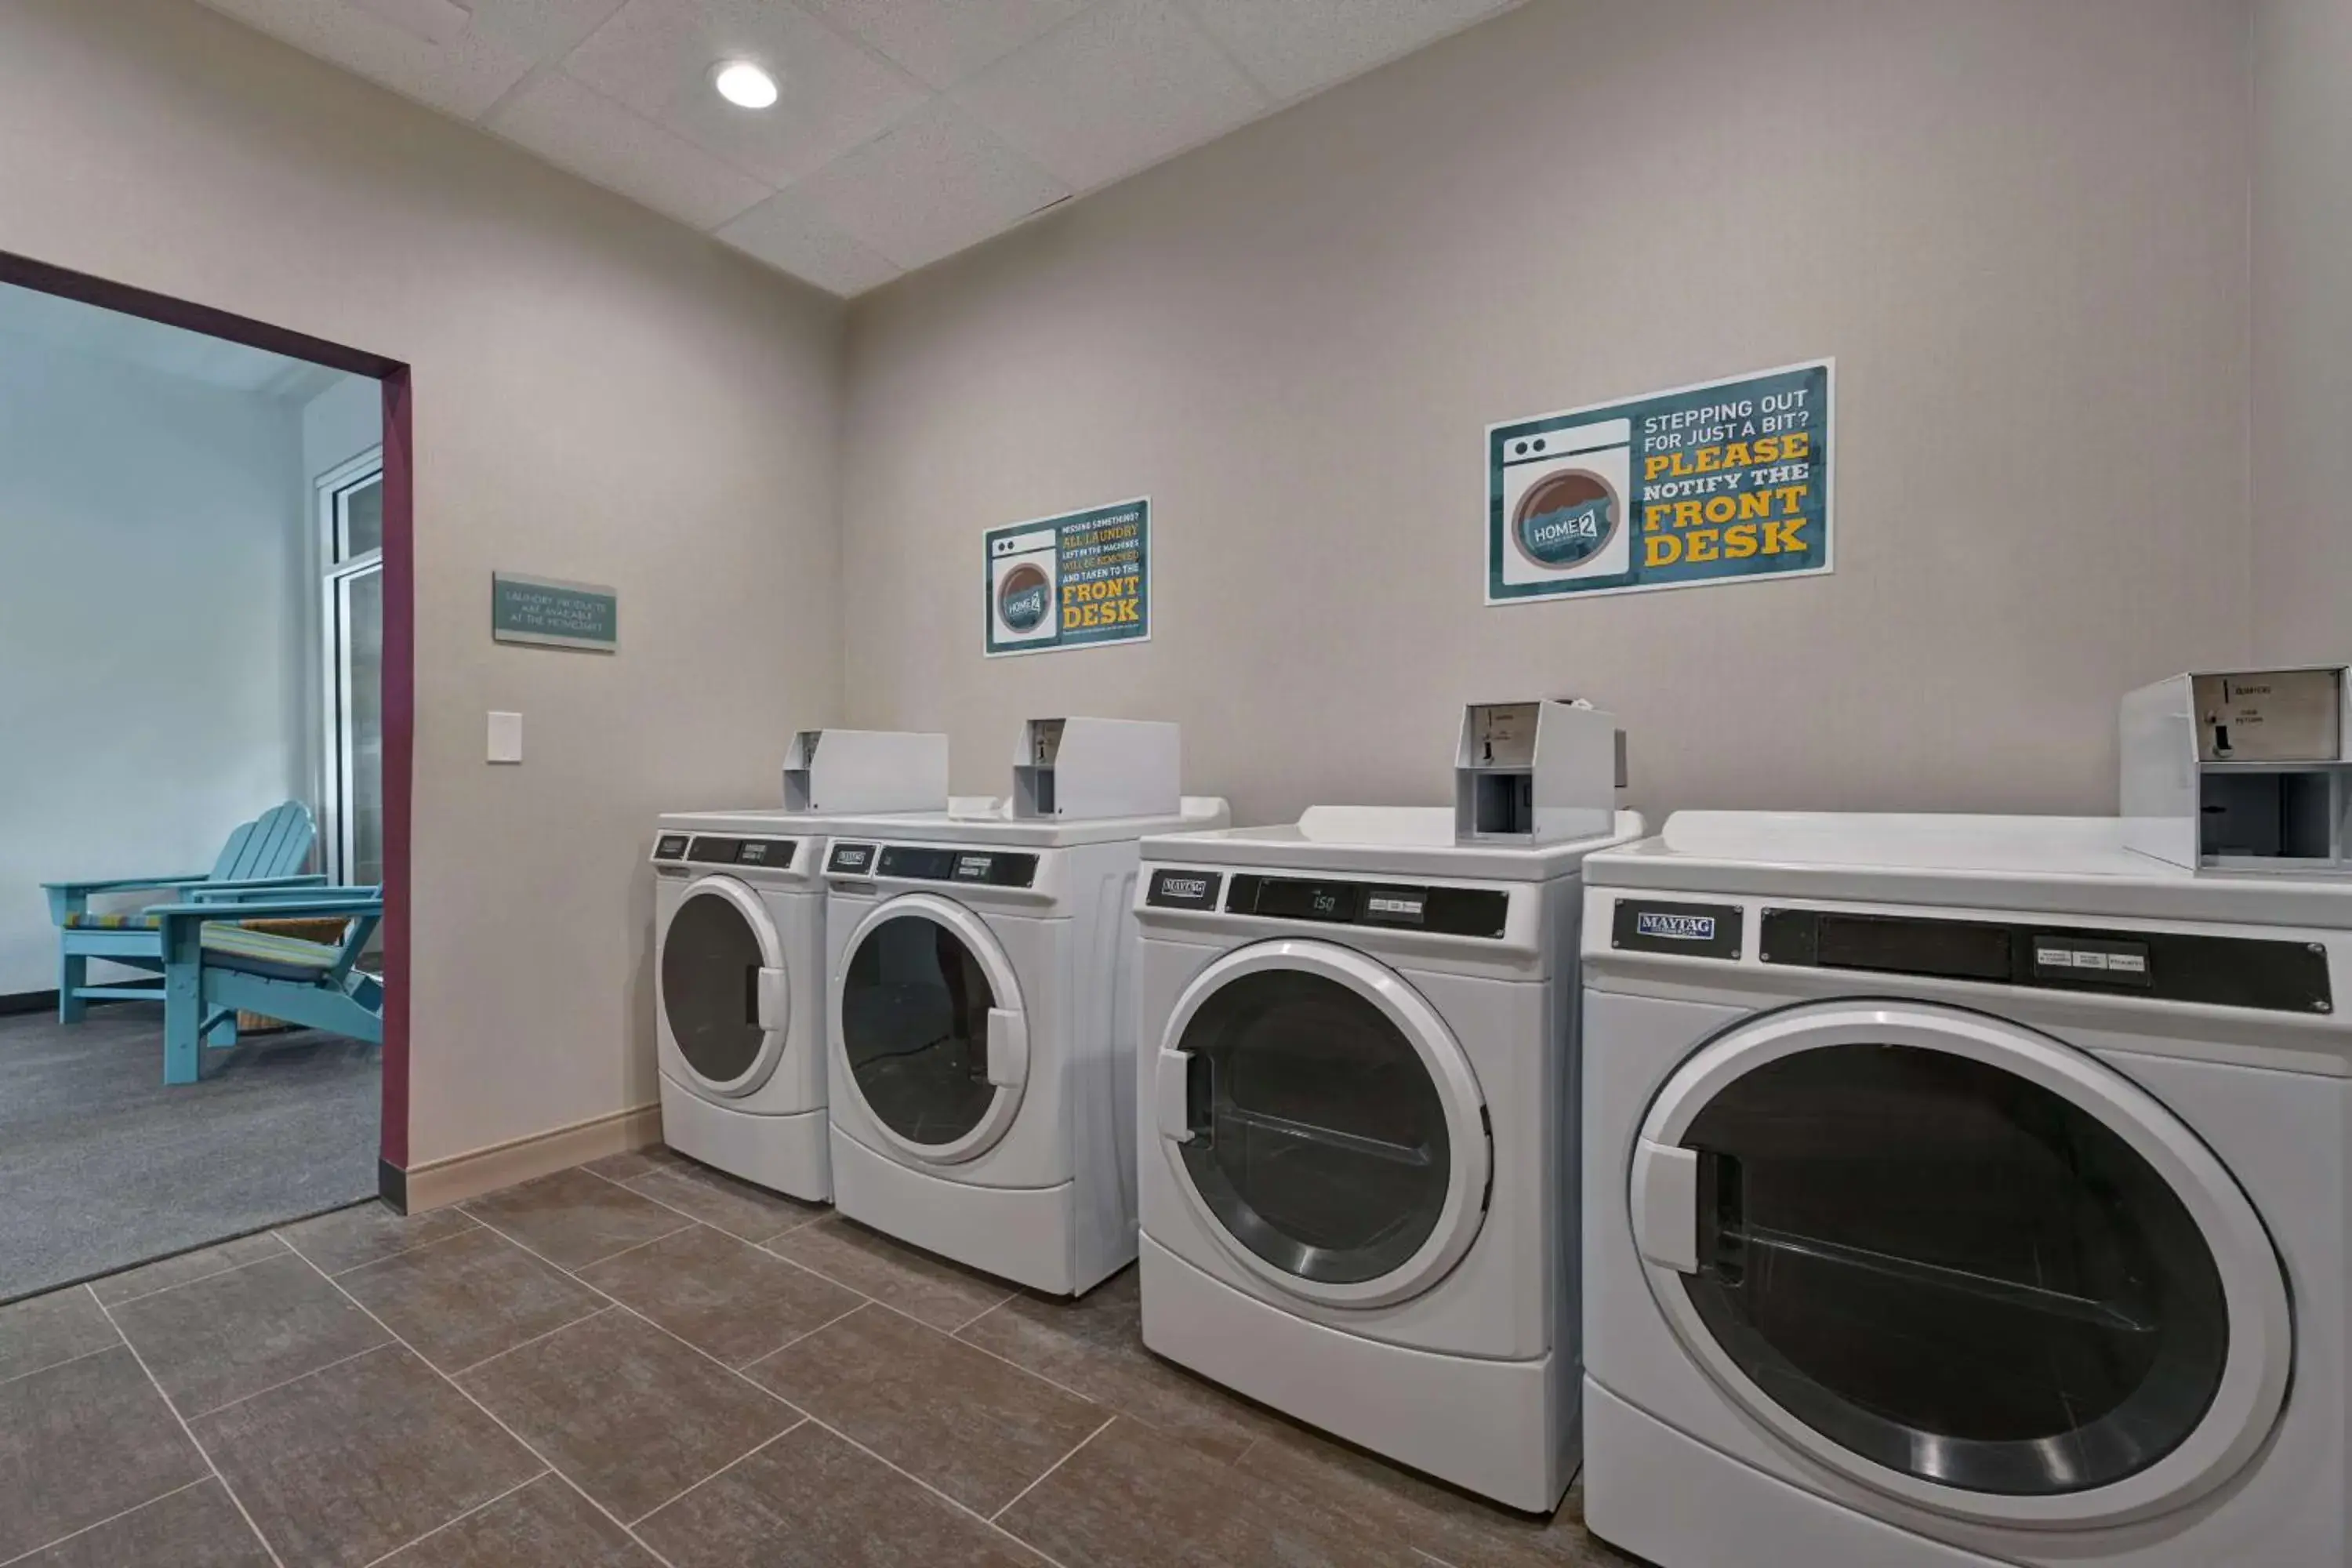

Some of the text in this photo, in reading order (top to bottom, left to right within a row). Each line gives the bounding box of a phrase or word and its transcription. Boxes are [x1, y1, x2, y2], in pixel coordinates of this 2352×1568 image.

[1644, 389, 1809, 434] STEPPING OUT
[1644, 410, 1809, 452] FOR JUST A BIT?
[1644, 432, 1809, 481] PLEASE
[1643, 463, 1809, 501] NOTIFY THE
[1644, 485, 1808, 531] FRONT
[1062, 512, 1140, 534] MISSING SOMETHING?
[1062, 523, 1139, 550] ALL LAUNDRY
[1062, 550, 1080, 560] LEFT
[1088, 545, 1102, 555] THE
[1103, 539, 1140, 553] MACHINES
[1644, 517, 1808, 568] DESK
[1062, 560, 1083, 572] WILL
[1062, 562, 1140, 584] AND TAKEN TO THE
[506, 591, 607, 613] LAUNDRY PRODUCTS
[1062, 576, 1139, 604] FRONT
[510, 614, 522, 622] AT
[528, 614, 543, 625] THE
[545, 608, 592, 620] AVAILABLE
[1062, 599, 1139, 628] DESK
[1642, 916, 1709, 932] MAYTAG
